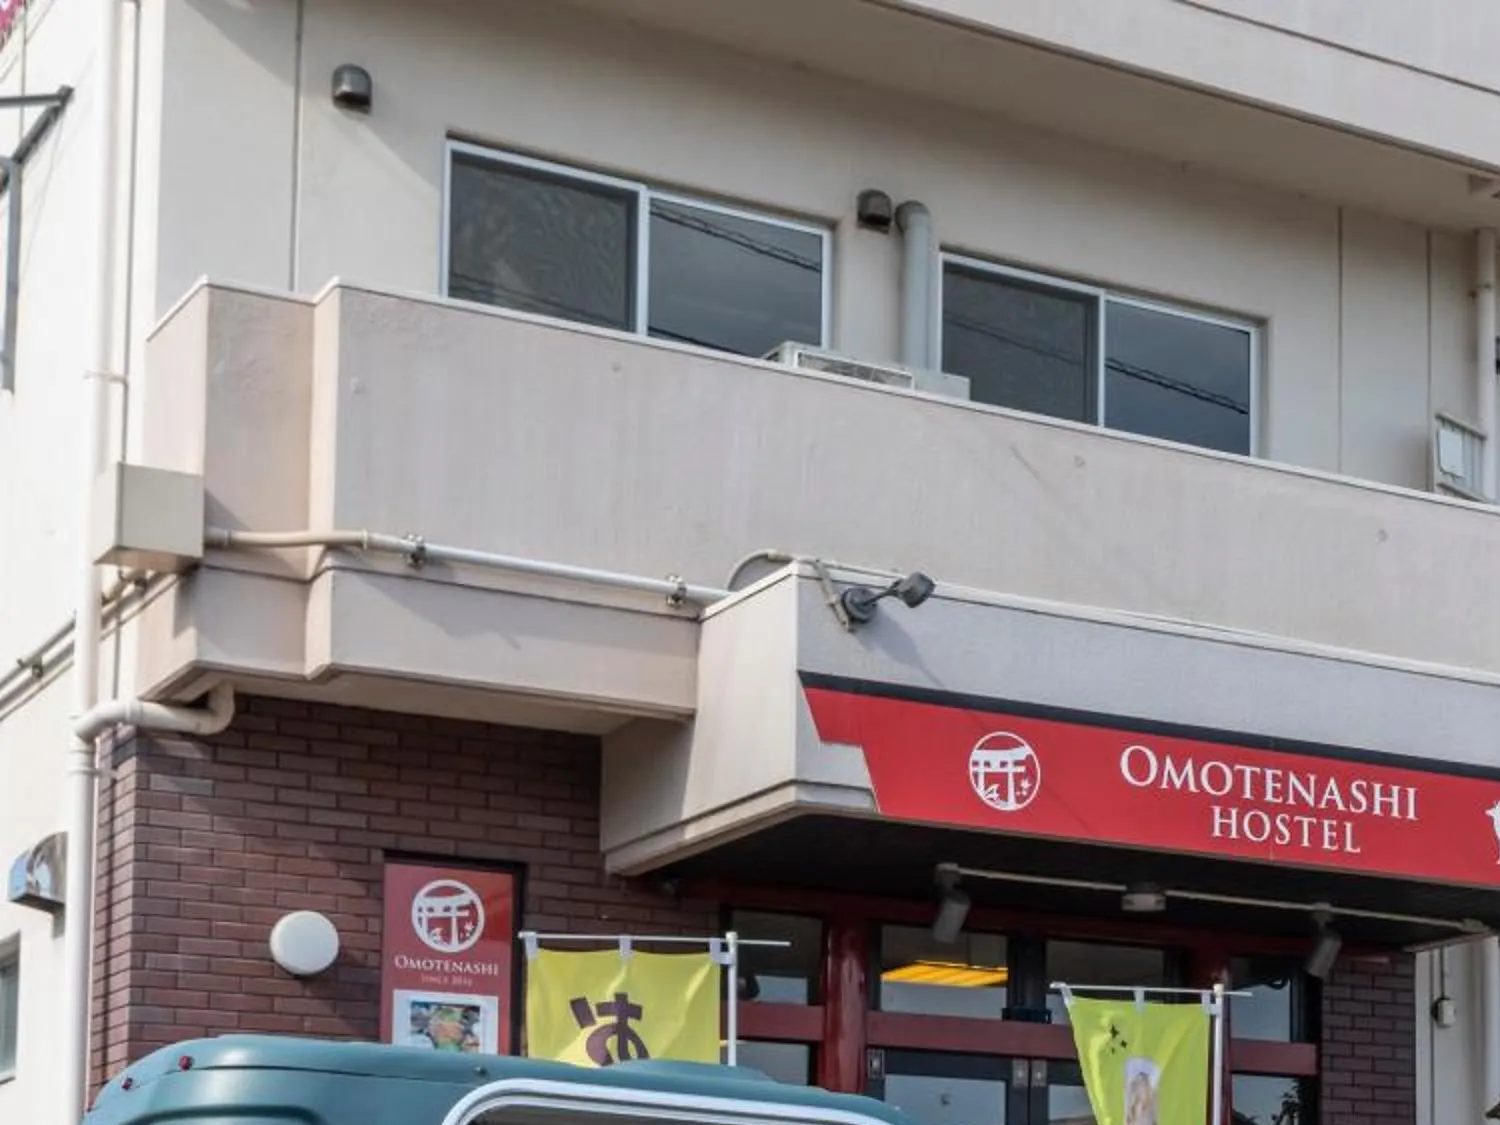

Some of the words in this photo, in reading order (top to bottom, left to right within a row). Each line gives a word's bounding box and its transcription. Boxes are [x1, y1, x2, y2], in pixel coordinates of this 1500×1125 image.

[1119, 745, 1420, 823] OMOTENASHI
[1210, 805, 1362, 854] HOSTEL
[394, 954, 499, 977] OMOTENASHI
